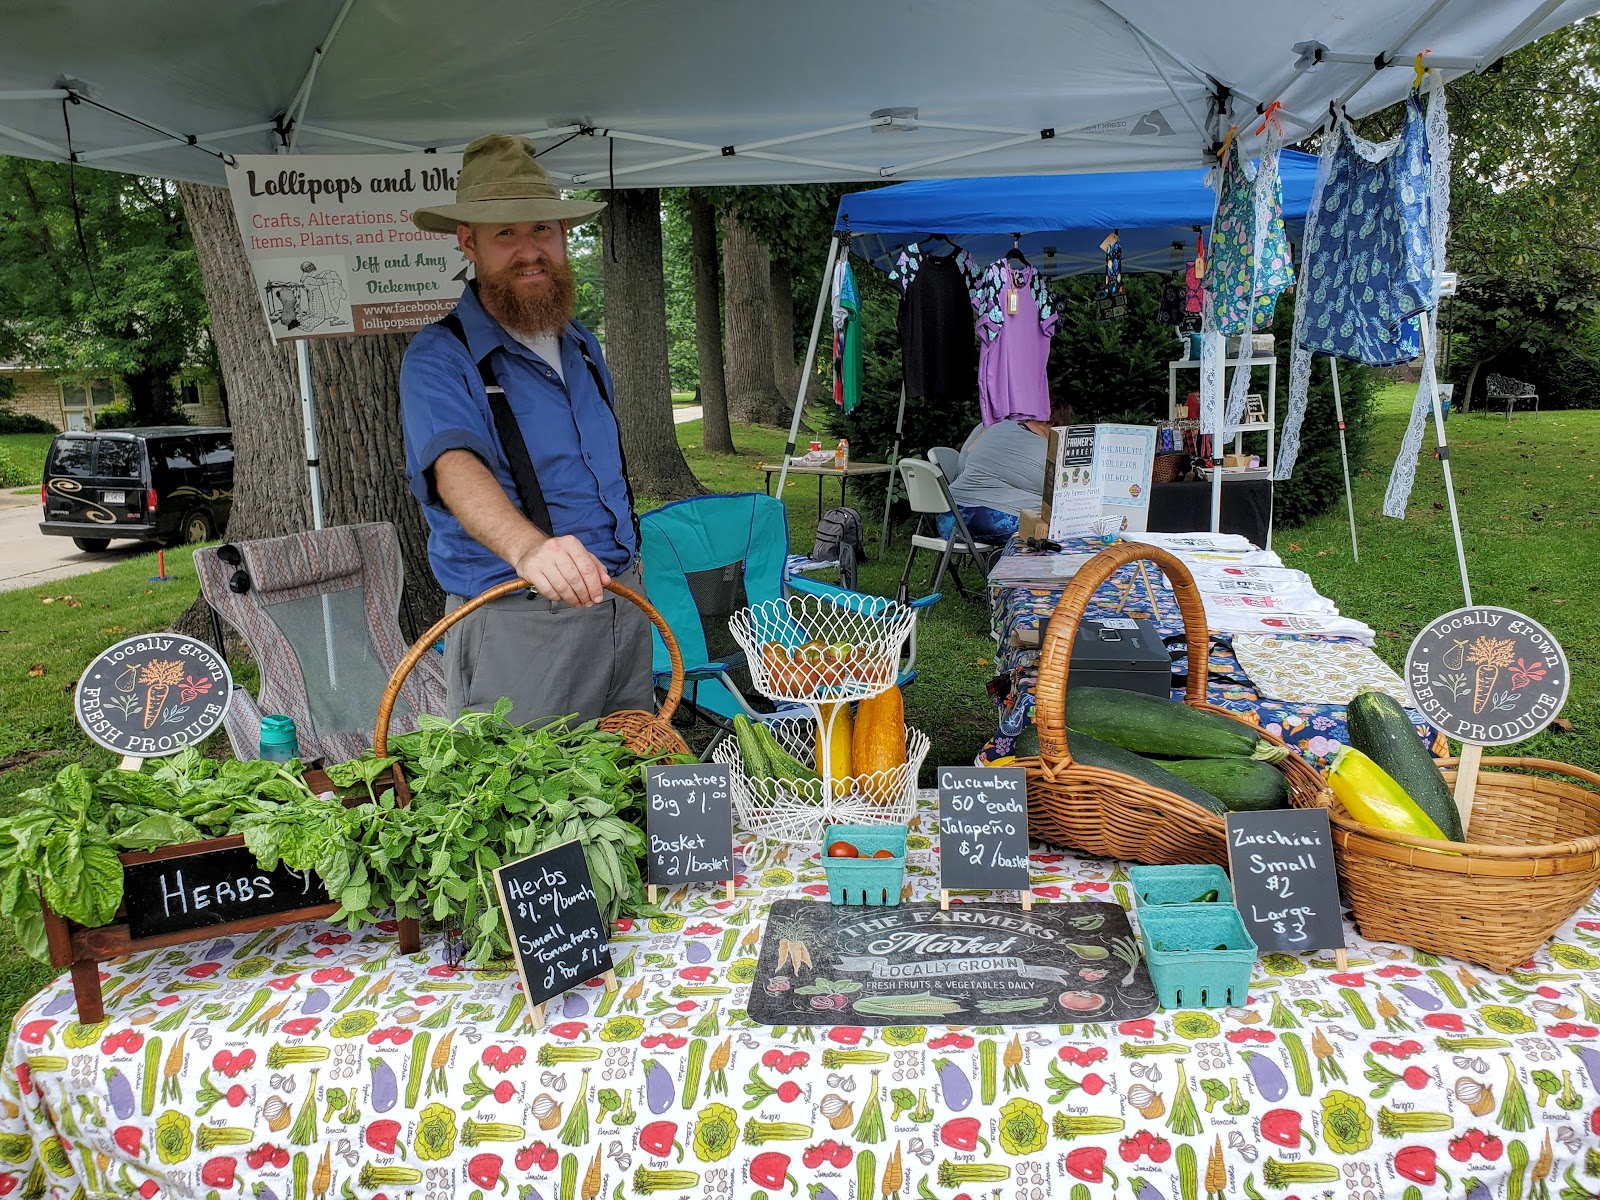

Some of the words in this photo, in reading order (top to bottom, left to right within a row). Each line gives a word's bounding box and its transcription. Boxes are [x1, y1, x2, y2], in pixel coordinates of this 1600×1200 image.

[247, 170, 362, 204] Lollipops
[370, 168, 416, 192] and
[252, 213, 304, 229] Crafts,
[308, 210, 396, 227] Alterations,
[250, 236, 296, 250] Items,
[300, 232, 352, 247] Plants,
[356, 230, 384, 244] and
[389, 229, 448, 242] Produce
[352, 256, 380, 274] Jeff
[384, 254, 411, 269] and
[414, 252, 447, 272] Amy
[366, 280, 440, 296] Dickemper
[363, 300, 460, 315] www.facebook.co
[1430, 610, 1503, 640] locally
[1508, 620, 1560, 668] grown
[102, 638, 174, 666] locally
[178, 643, 224, 682] grown
[1412, 660, 1453, 726] FRESH
[1454, 693, 1558, 740] PRODUCE
[82, 686, 124, 744] FRESH
[124, 703, 223, 752] PRODUCE
[652, 772, 726, 788] Tomatoes
[942, 772, 1018, 790] Cucumber
[652, 794, 680, 816] Big
[986, 798, 1023, 814] each
[941, 817, 1016, 842] Jalapeño
[1232, 828, 1322, 847] Zucchini
[650, 834, 706, 854] Basket
[1250, 853, 1317, 874] Small
[160, 869, 274, 918] HERBS
[508, 867, 567, 900] Herbs
[1265, 875, 1294, 898] $2
[837, 916, 902, 938] THE
[912, 911, 1060, 940] FARMERS
[1251, 904, 1317, 926] Large
[518, 923, 565, 956] Small
[1272, 921, 1308, 942] $3
[533, 926, 599, 964] Tomatoes
[868, 932, 1018, 954] Market
[543, 966, 555, 990] 2
[556, 960, 580, 980] for
[879, 962, 950, 977] LOCALLY
[958, 958, 1018, 972] GROWN
[866, 981, 895, 989] FRESH
[898, 981, 930, 989] FRUITS
[934, 981, 942, 989] &
[946, 980, 1005, 989] VEGETABLES
[1008, 981, 1035, 990] DAILY
